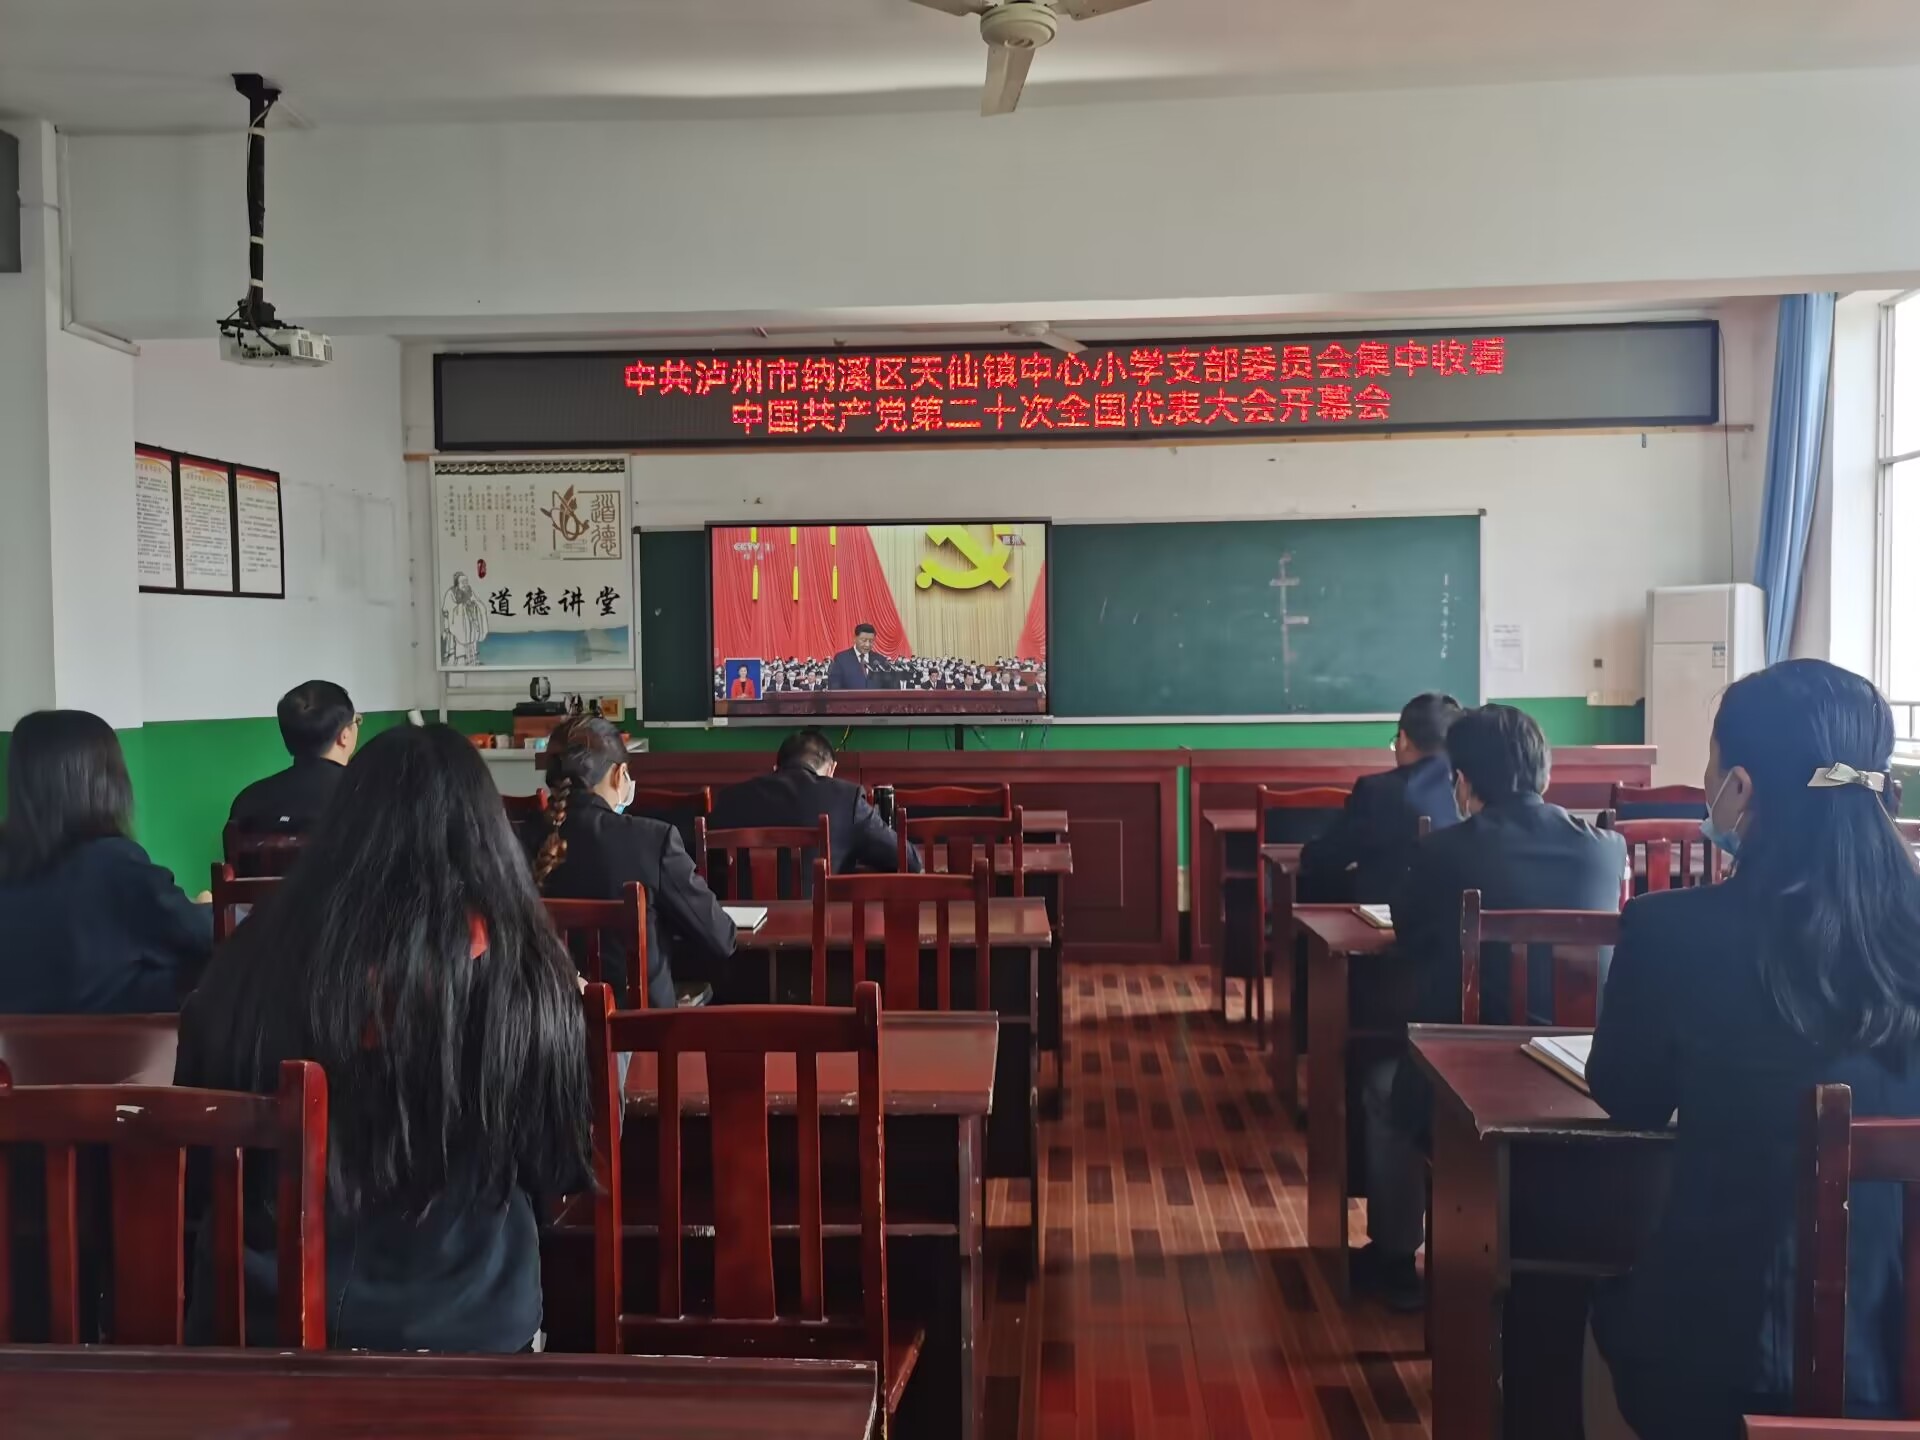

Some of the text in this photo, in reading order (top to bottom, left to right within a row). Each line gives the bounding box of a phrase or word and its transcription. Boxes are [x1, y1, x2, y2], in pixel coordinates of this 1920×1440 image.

[624, 337, 1505, 396] 中共泸州市纳溪区天仙镇中心小学支部委员会集中收看
[732, 383, 1391, 436] 中国共产党第二十次全国代表大会开幕会
[488, 585, 621, 618] 道德讲堂
